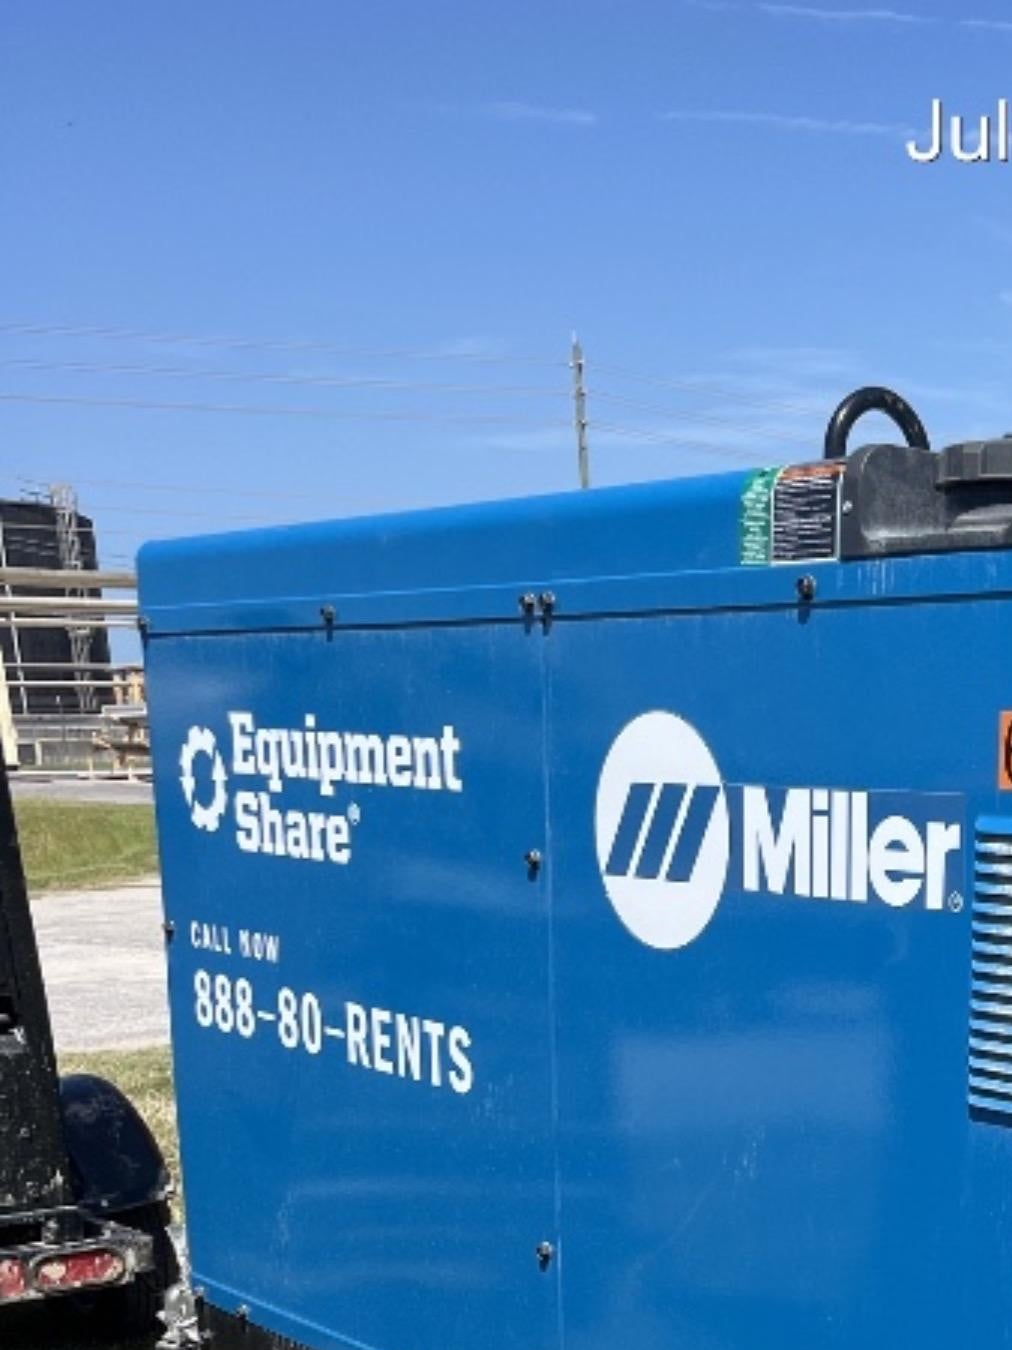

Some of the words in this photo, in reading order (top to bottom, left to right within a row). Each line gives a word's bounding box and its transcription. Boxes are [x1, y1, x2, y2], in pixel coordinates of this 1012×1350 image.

[226, 710, 464, 796] Equipment
[190, 920, 232, 955] CALL
[239, 928, 280, 963] NOW
[193, 968, 474, 1094] 888-80-RENTS
